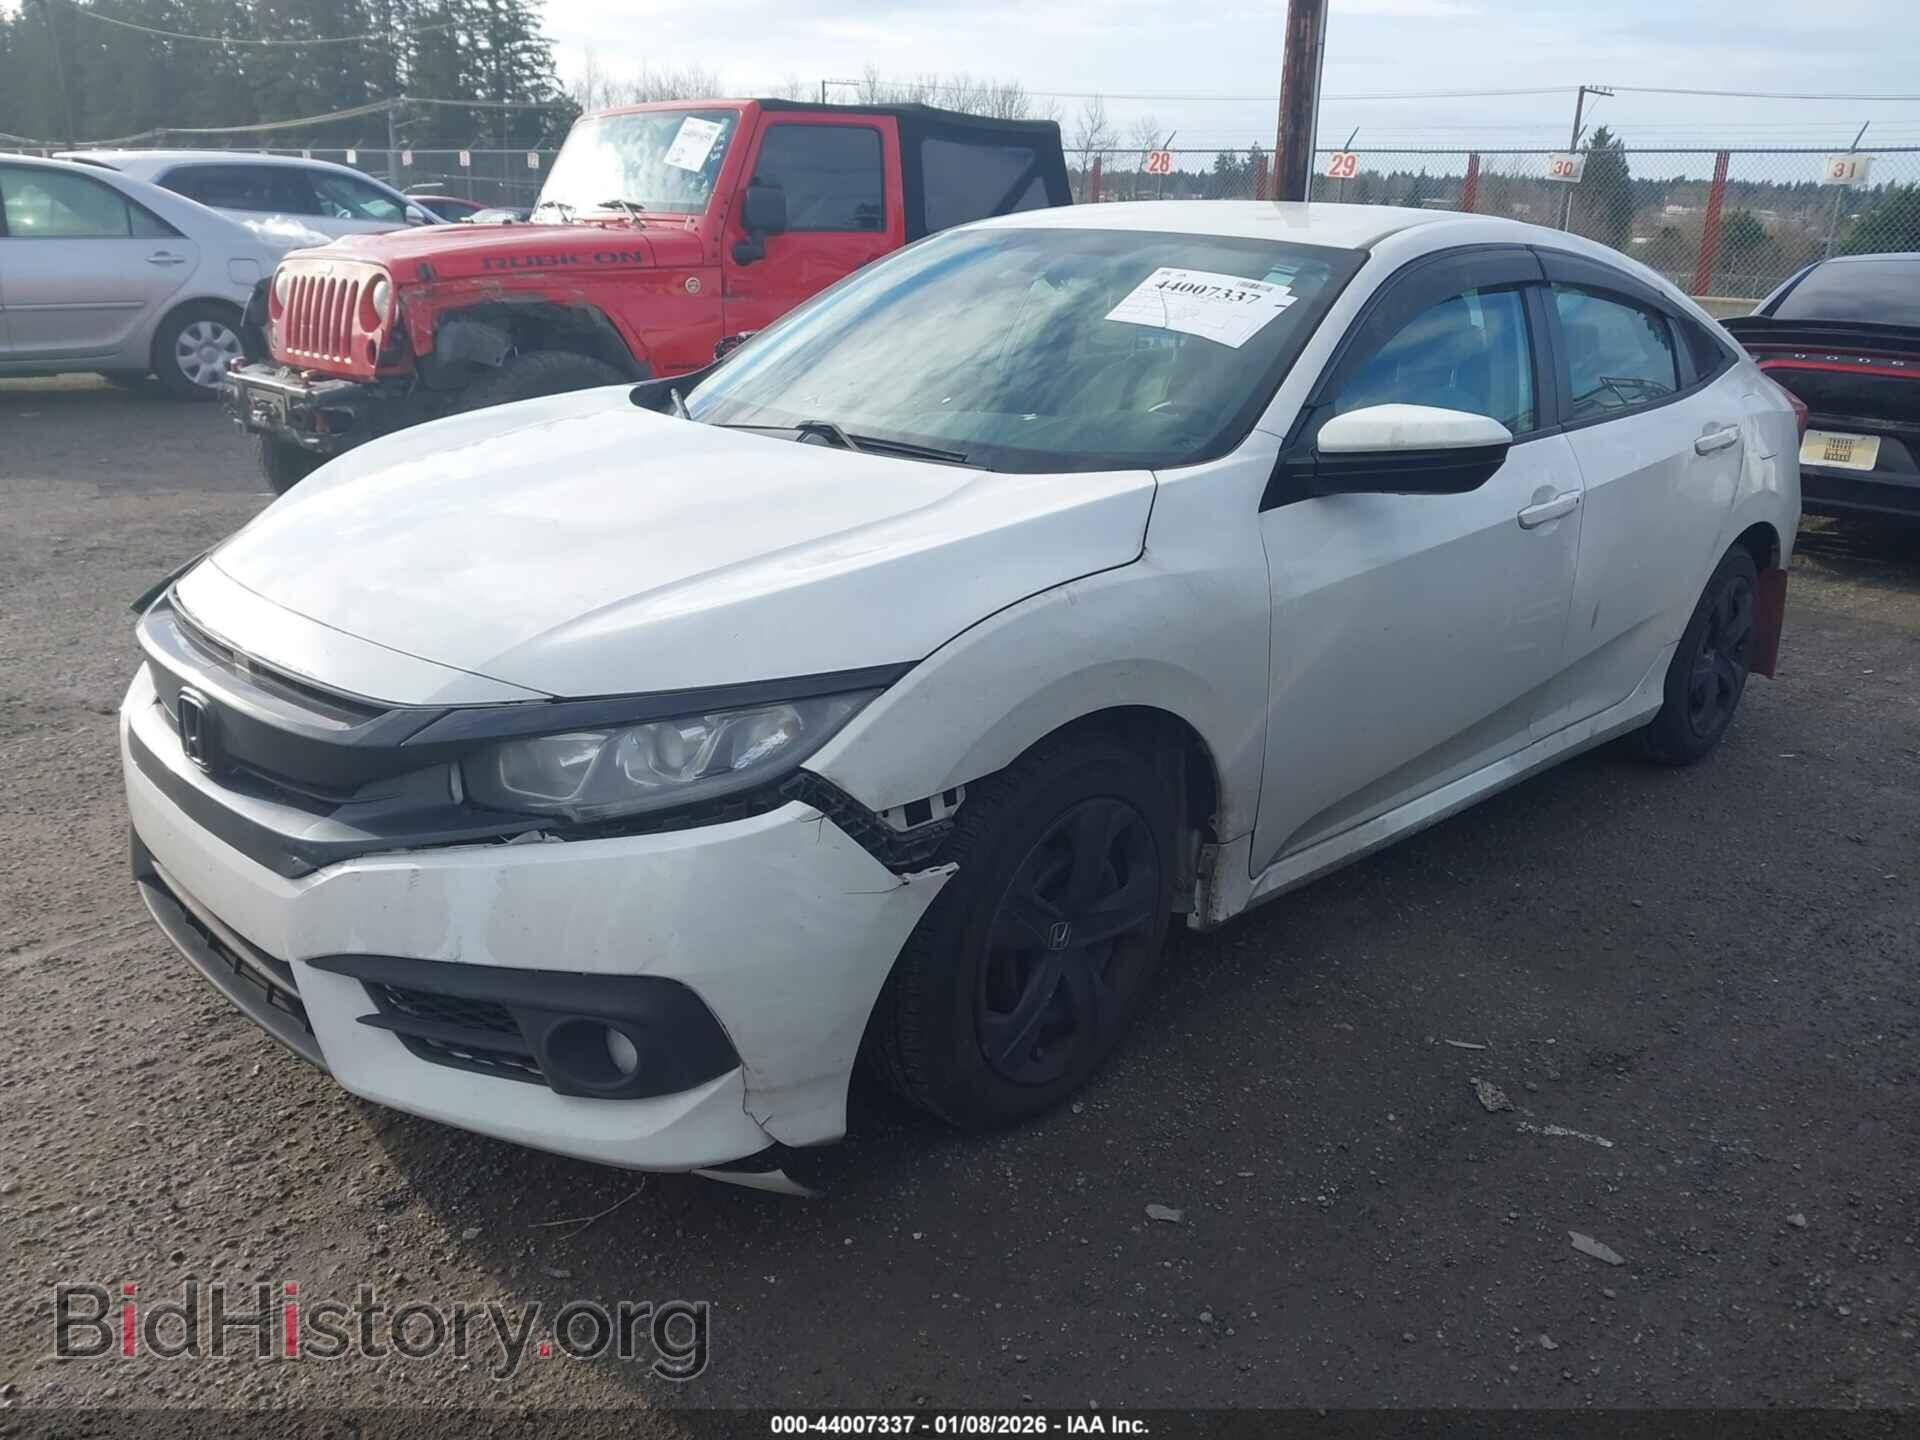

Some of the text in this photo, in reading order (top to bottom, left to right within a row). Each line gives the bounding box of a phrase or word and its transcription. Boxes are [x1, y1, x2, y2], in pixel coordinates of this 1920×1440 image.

[1151, 152, 1170, 172] 28
[1329, 154, 1356, 176] 29
[1553, 160, 1573, 176] 30
[1833, 161, 1856, 177] 31
[1154, 280, 1262, 304] 44007337
